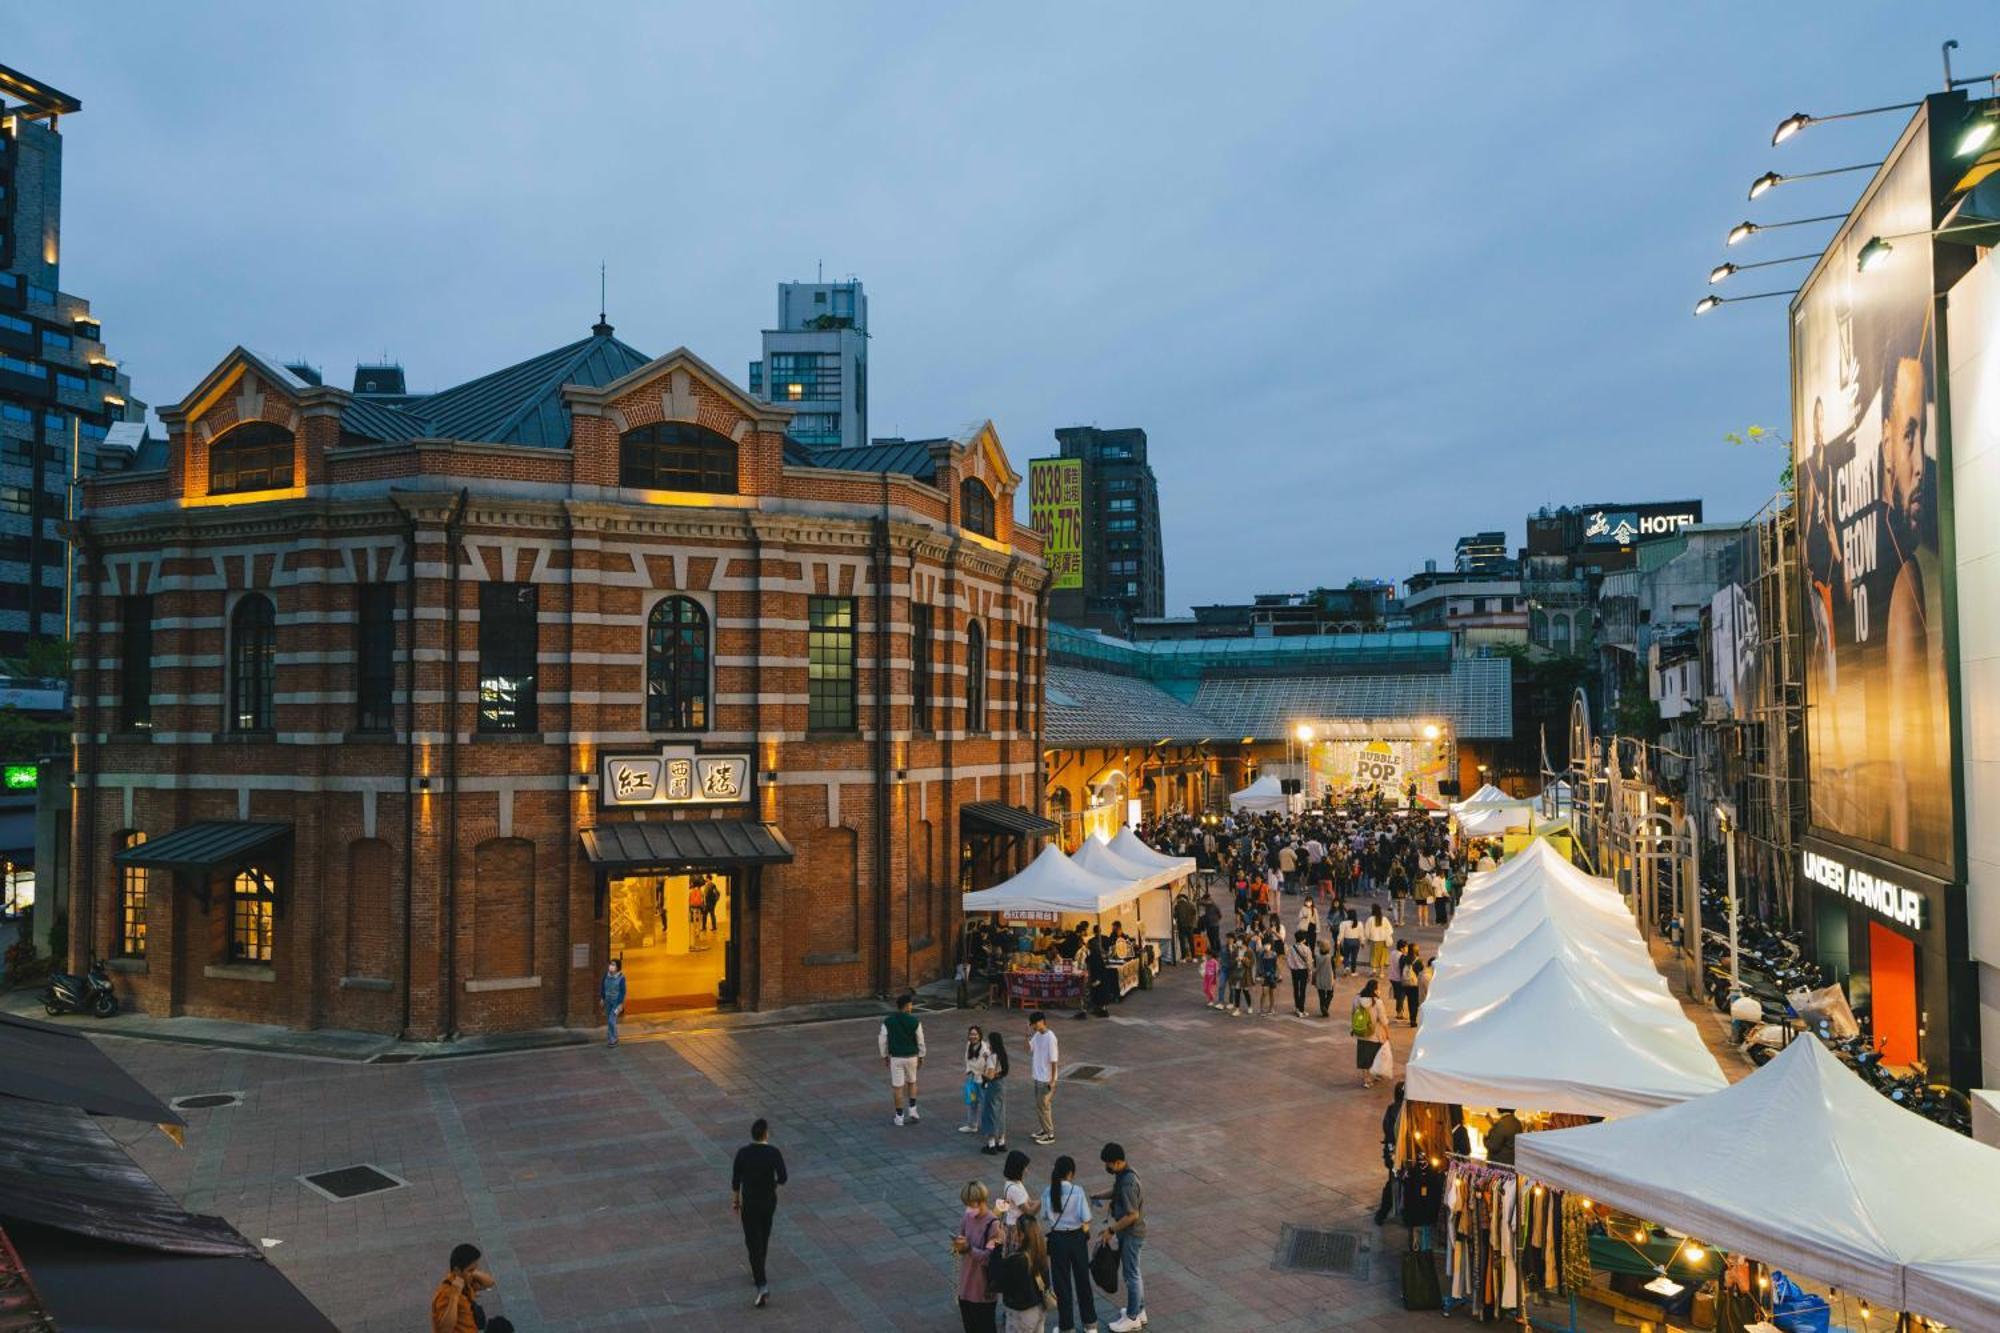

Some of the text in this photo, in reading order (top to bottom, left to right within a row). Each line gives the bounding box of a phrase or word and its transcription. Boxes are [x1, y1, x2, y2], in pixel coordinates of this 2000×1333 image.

[1032, 465, 1061, 506] 0938
[1837, 450, 1879, 523] CURRY
[1843, 512, 1878, 581] FLOW
[1853, 584, 1869, 643] 10
[1356, 761, 1393, 780] POP
[1359, 751, 1401, 765] BUBBLE
[1803, 850, 1921, 931] UNDER ARMOUR
